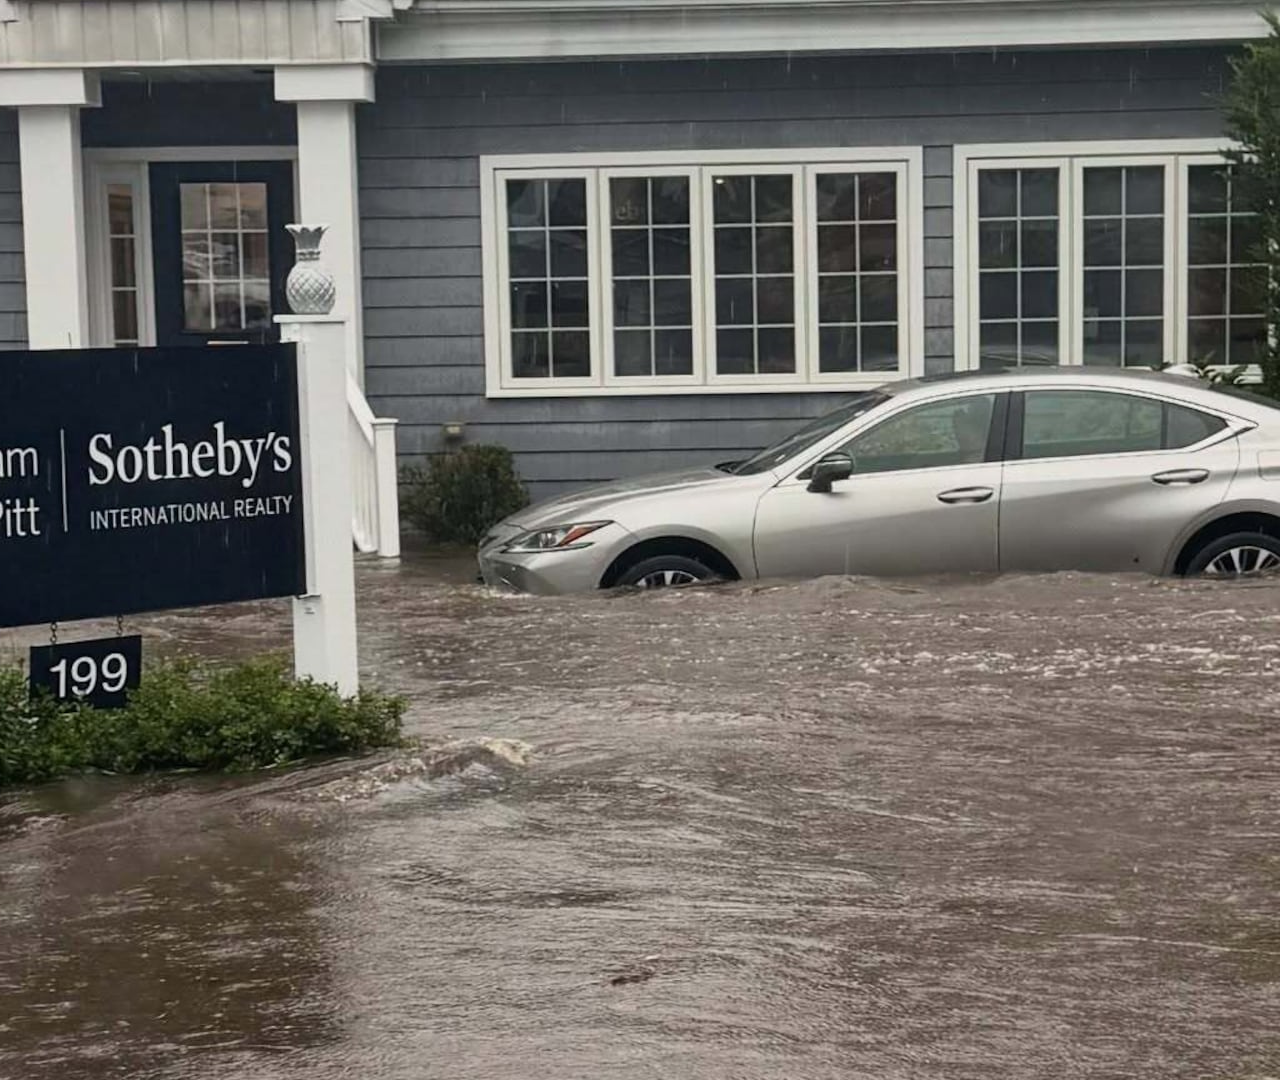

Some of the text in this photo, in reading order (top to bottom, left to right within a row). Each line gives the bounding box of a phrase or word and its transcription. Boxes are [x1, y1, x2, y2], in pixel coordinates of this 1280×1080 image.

[88, 421, 292, 488] Sotheby's
[90, 495, 293, 530] INTERNATIONAL REALTY
[49, 652, 128, 699] 199
